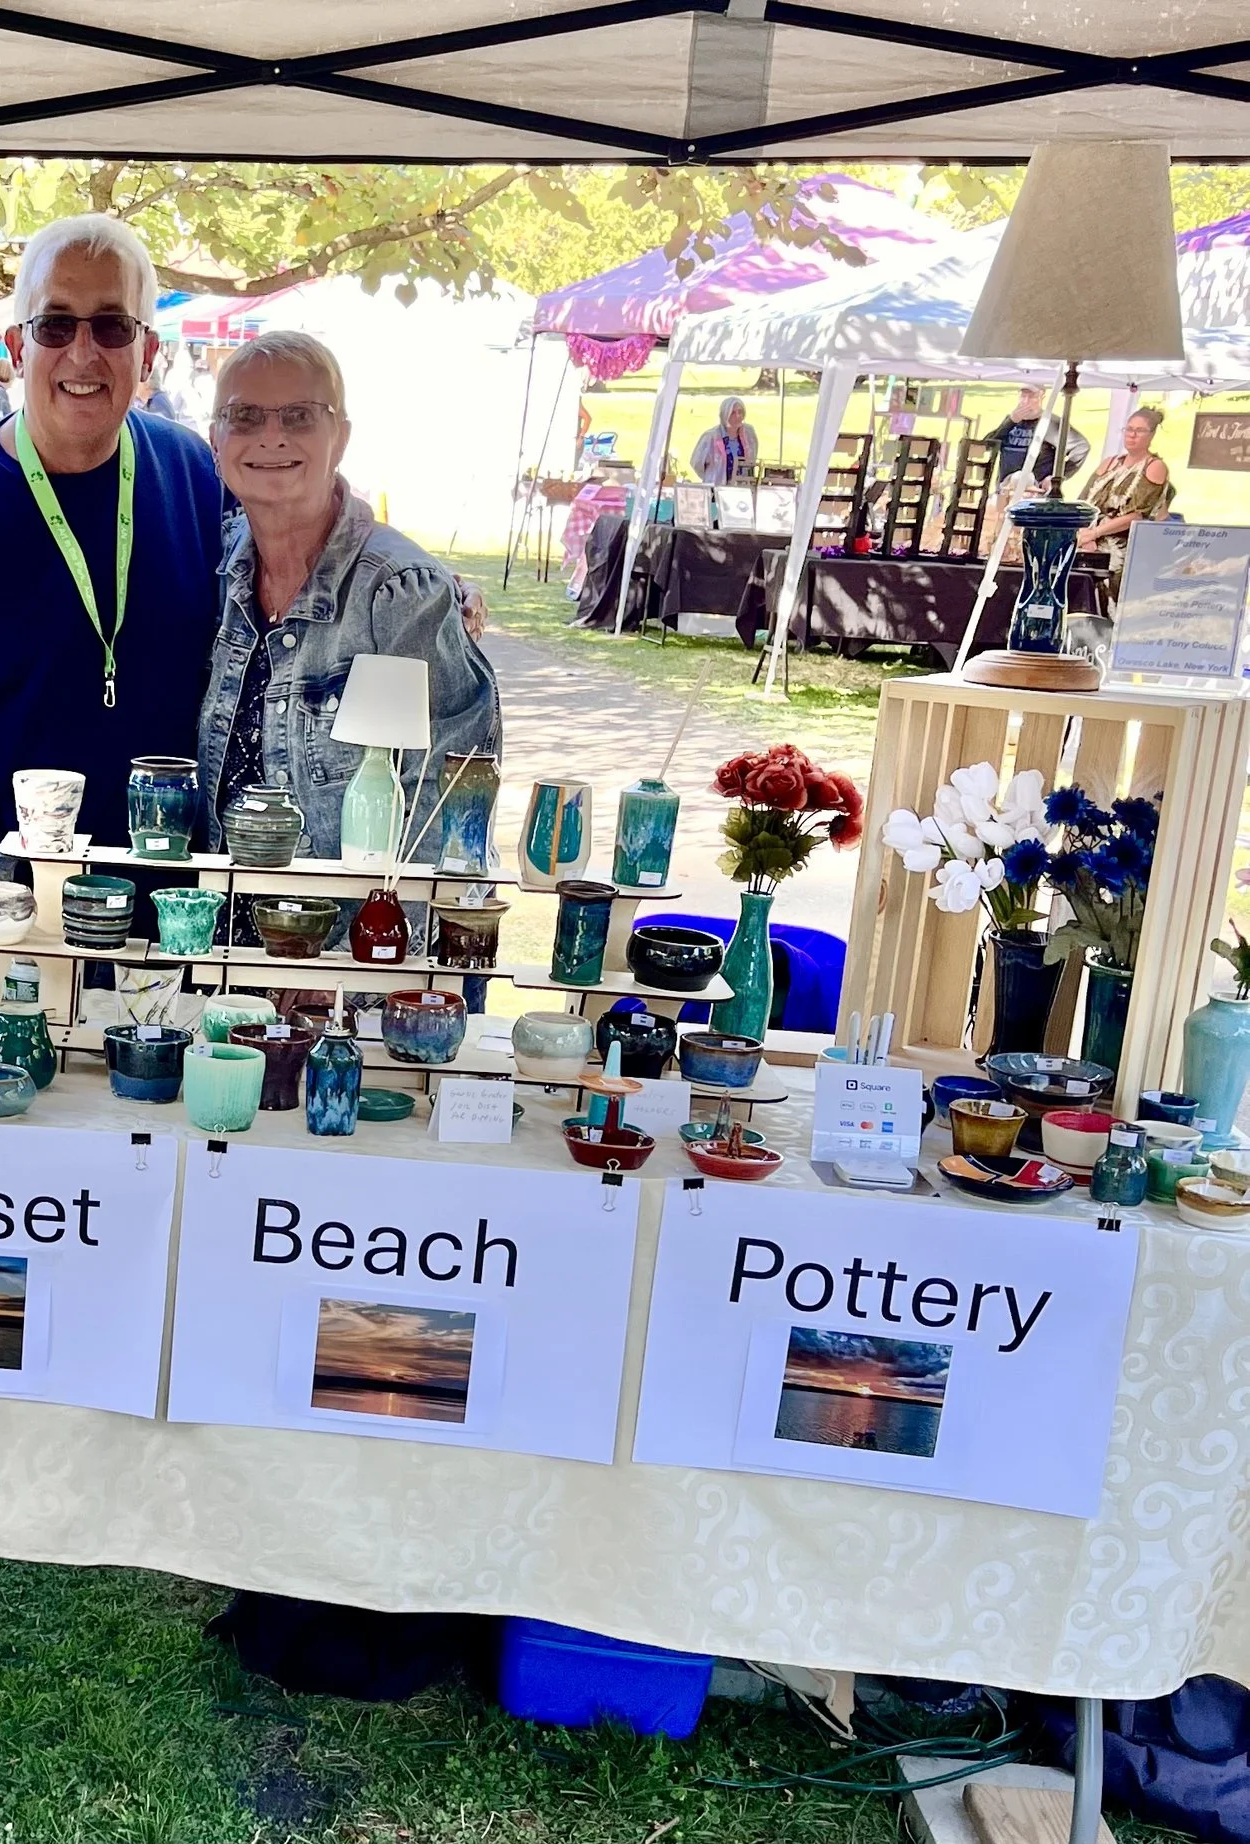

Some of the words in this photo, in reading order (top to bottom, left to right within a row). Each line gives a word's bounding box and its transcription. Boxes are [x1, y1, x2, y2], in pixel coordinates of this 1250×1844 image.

[1197, 528, 1229, 538] Beach
[1166, 639, 1190, 650] Tony
[1183, 662, 1205, 671] New
[1207, 663, 1230, 672] York
[859, 1082, 892, 1092] Square
[839, 1120, 855, 1128] VISA
[252, 1196, 519, 1289] Beach
[728, 1236, 1054, 1354] Pottery
